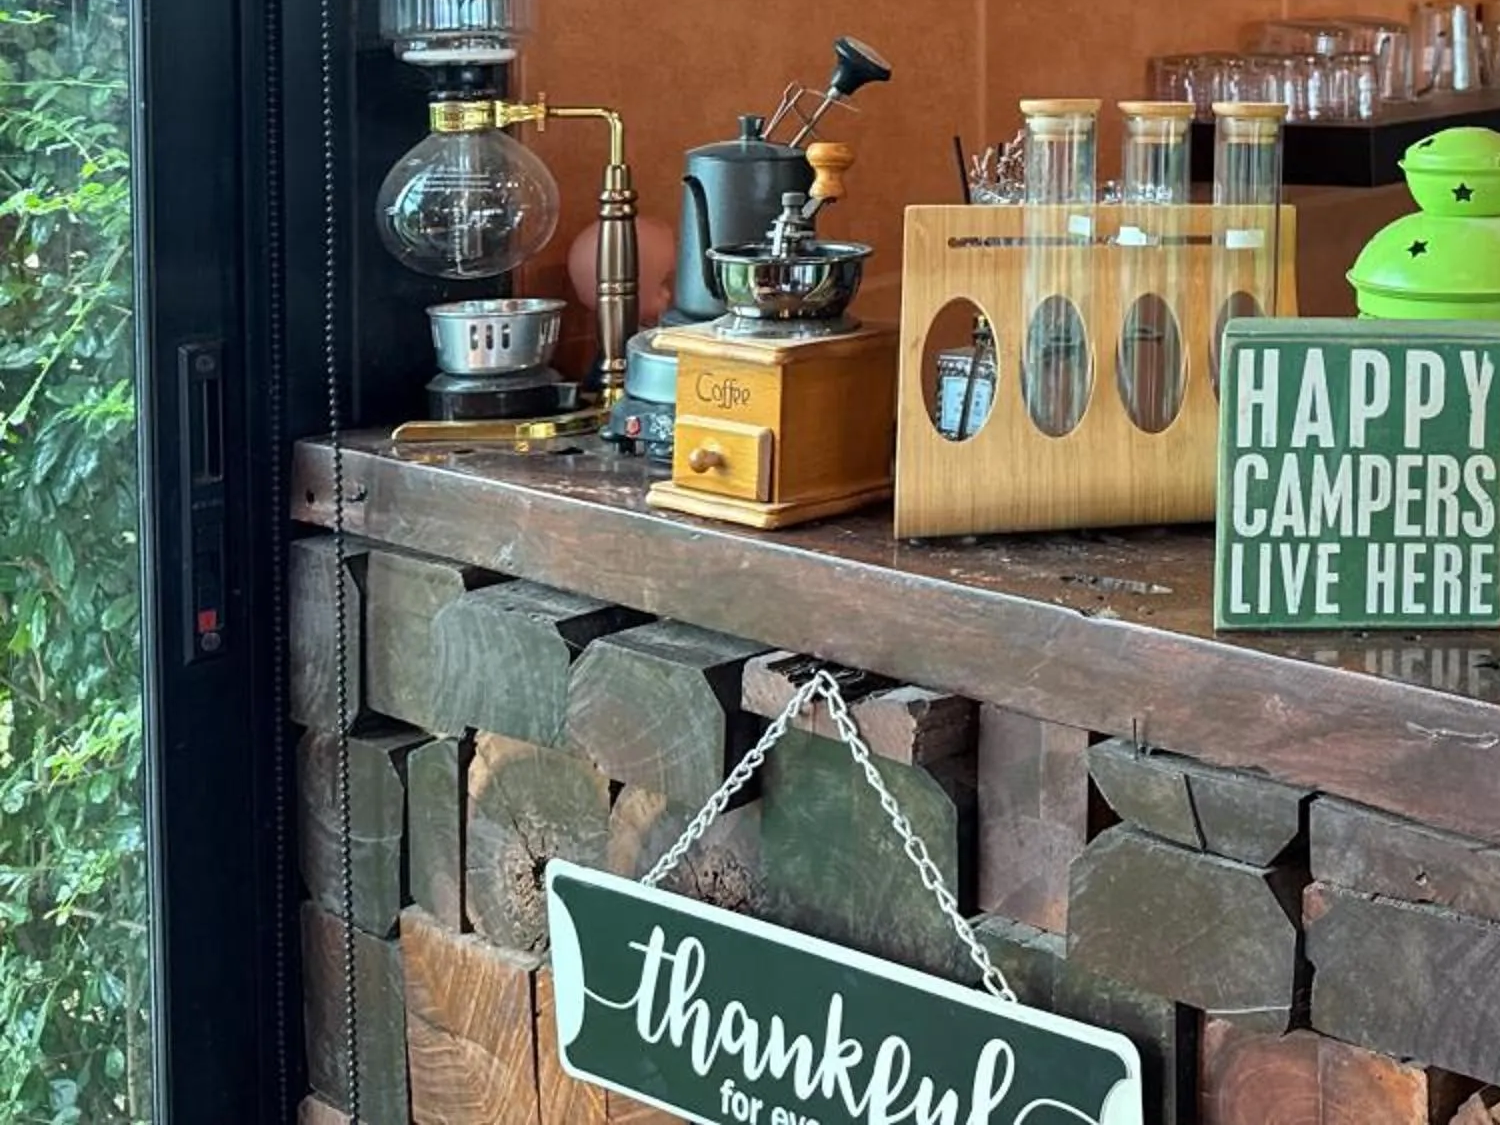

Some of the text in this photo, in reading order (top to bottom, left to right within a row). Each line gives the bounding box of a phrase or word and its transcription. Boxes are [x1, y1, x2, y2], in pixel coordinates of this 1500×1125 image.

[696, 373, 751, 409] Coffee
[1236, 348, 1495, 449] HAPPY
[1233, 453, 1497, 538] CAMPERS
[1230, 542, 1495, 615] LIVE HERE
[720, 1078, 764, 1125] for
